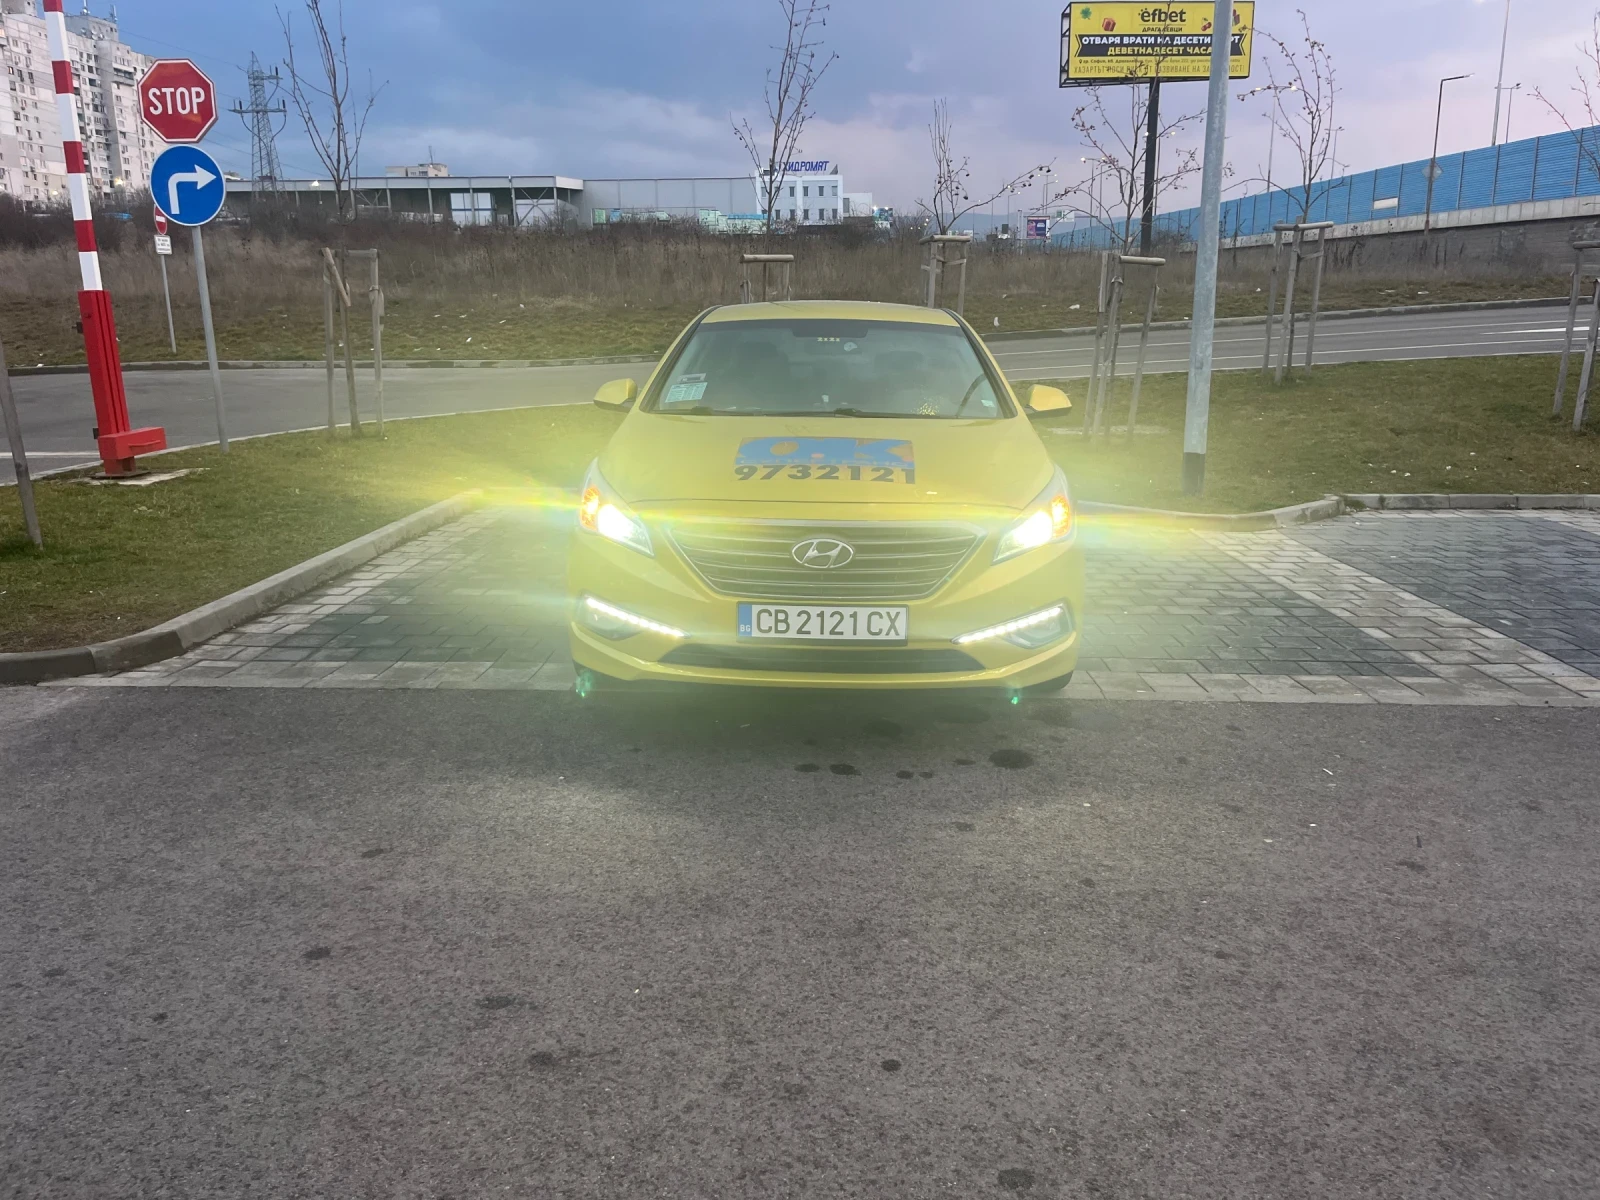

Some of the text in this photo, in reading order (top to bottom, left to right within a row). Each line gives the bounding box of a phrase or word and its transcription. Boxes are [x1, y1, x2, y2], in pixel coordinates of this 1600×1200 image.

[1139, 8, 1187, 23] efbet
[1081, 36, 1121, 45] ОТВАРЯ
[1122, 36, 1155, 45] ВРАТИ
[1156, 36, 1172, 45] НА
[1173, 36, 1212, 46] ДЕСЕТИ
[1107, 46, 1213, 56] ДЕВЕТНАДЕСЕТ ЧАСА
[148, 86, 206, 116] STOP
[734, 464, 916, 485] 9732121
[739, 624, 751, 632] BG
[796, 609, 858, 636] 2121
